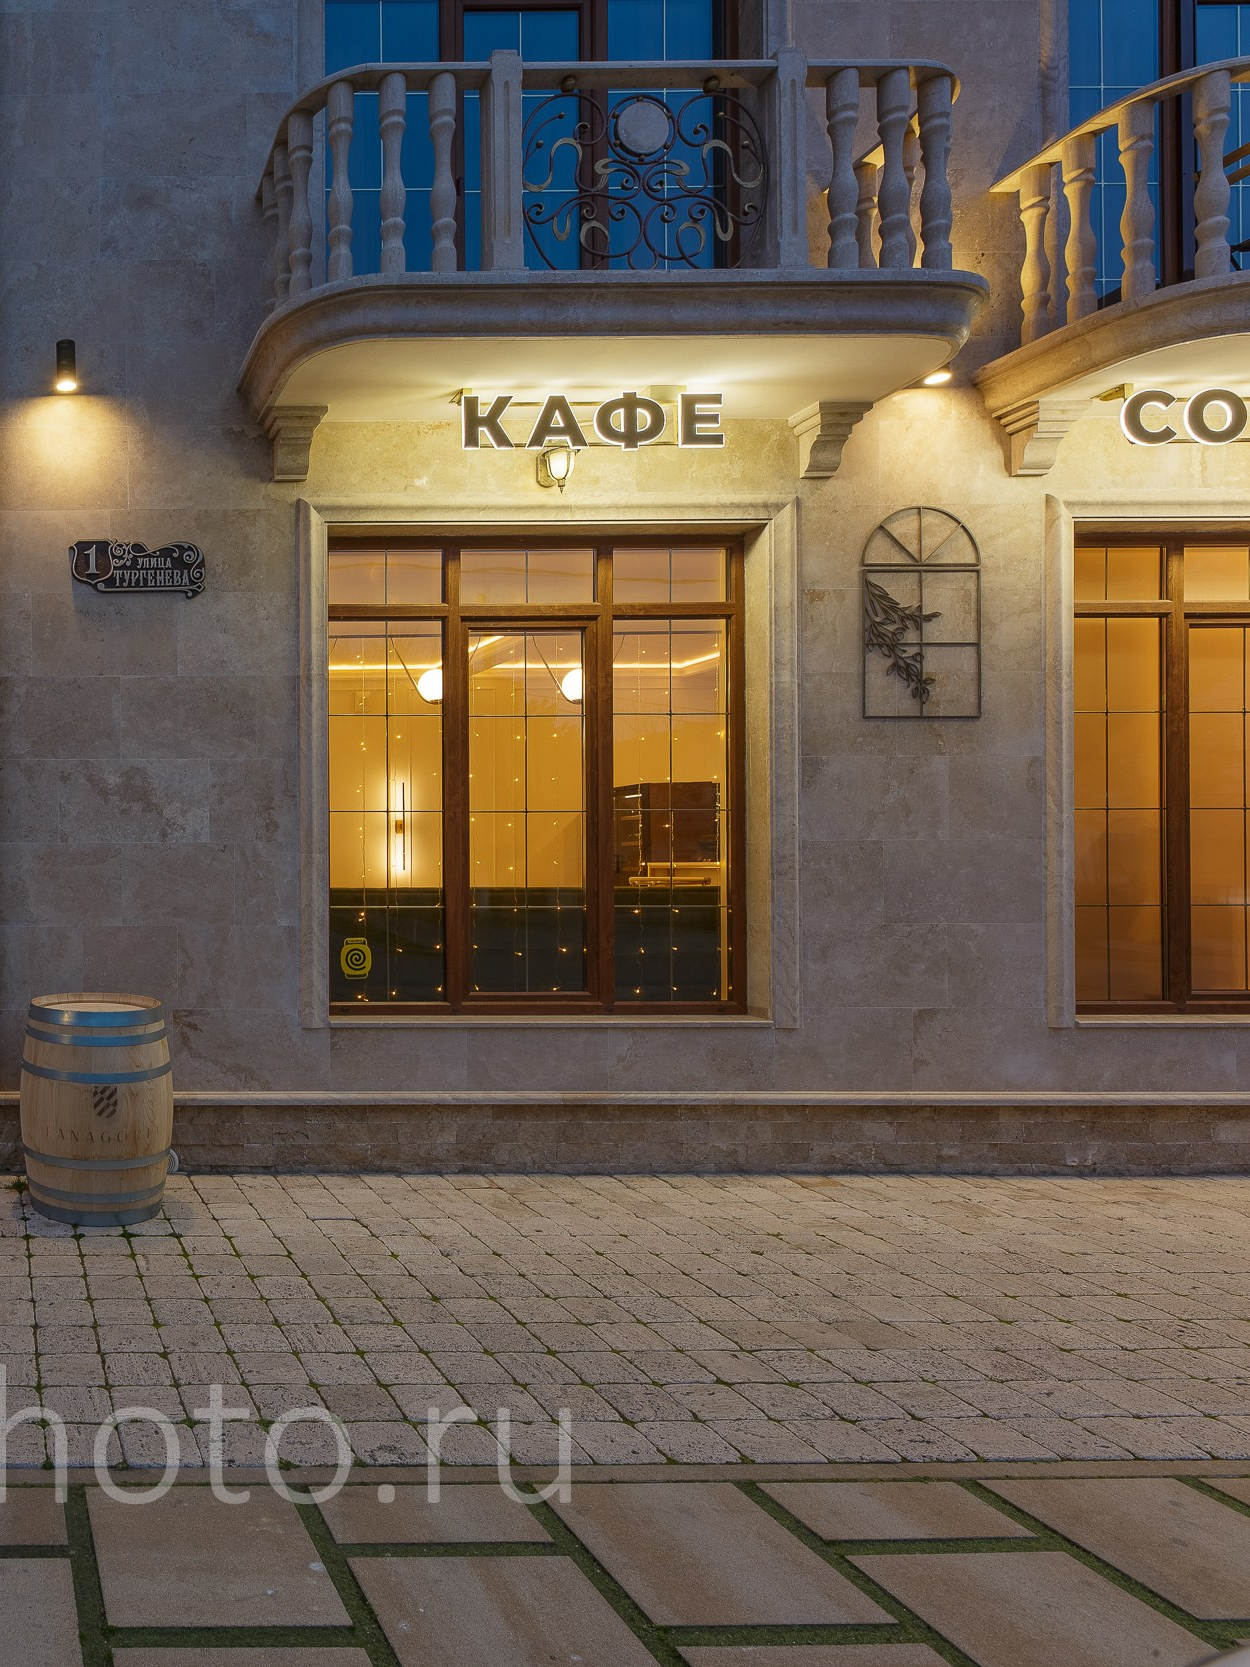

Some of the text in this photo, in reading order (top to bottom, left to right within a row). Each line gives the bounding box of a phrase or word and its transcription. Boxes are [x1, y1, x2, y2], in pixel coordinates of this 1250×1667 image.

[461, 391, 725, 450] КАФЕ
[83, 544, 100, 574] 1
[136, 557, 172, 569] УЛИЦА
[113, 570, 190, 587] ТУРГЕНЕВА
